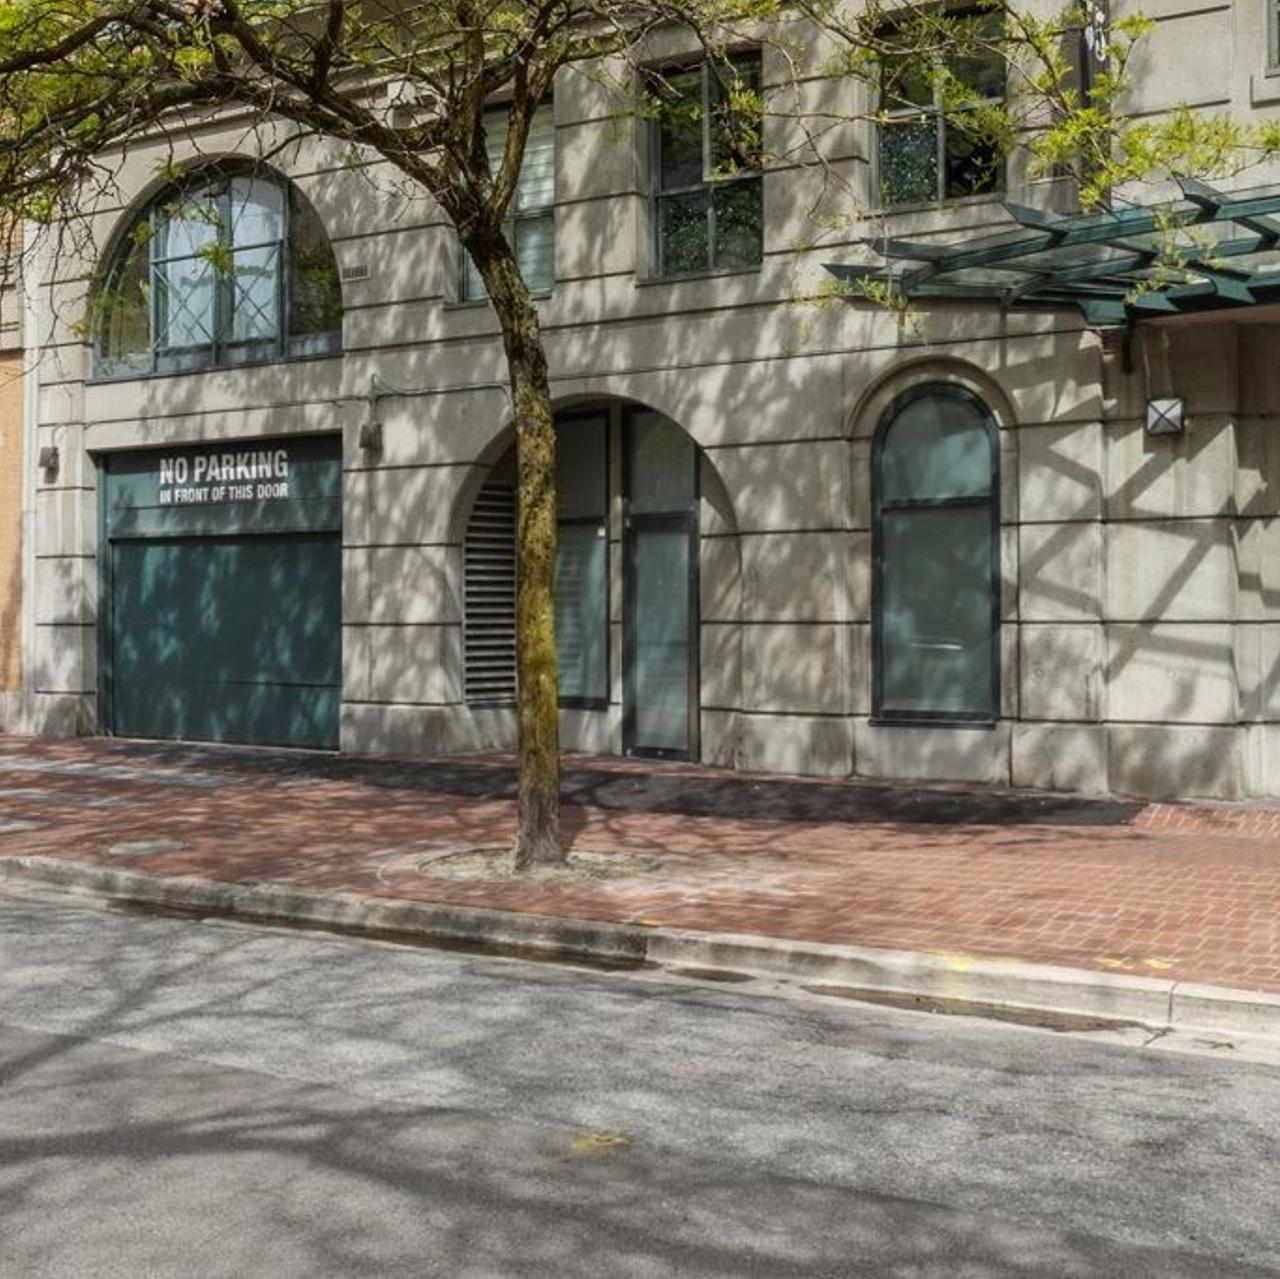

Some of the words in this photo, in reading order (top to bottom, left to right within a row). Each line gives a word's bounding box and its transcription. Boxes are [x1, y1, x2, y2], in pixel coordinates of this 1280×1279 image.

[160, 457, 188, 484] NO
[194, 450, 289, 482] PARKING
[160, 489, 171, 504] IN
[174, 487, 209, 502] FRONT
[211, 486, 226, 500] OF
[228, 484, 253, 499] THIS
[257, 482, 289, 498] DOOR
